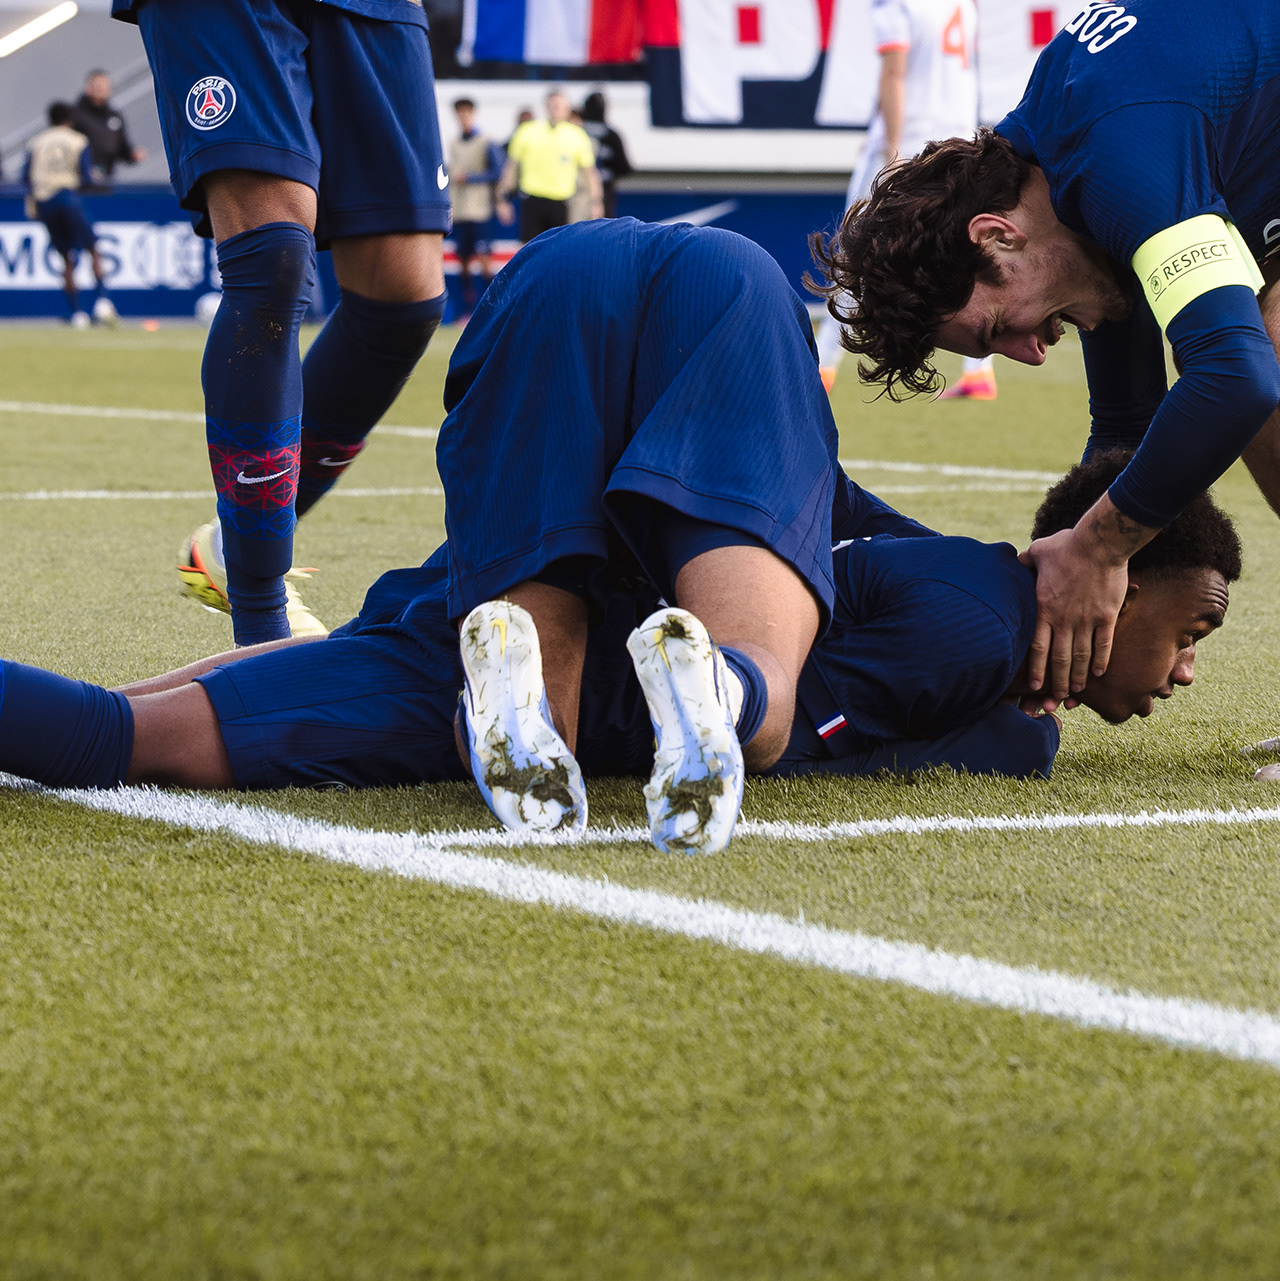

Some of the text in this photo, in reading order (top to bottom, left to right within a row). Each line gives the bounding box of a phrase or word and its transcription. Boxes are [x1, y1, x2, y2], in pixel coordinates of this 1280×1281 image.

[941, 5, 969, 70] 4
[191, 78, 226, 96] PARIS
[1163, 243, 1230, 281] RESPECT
